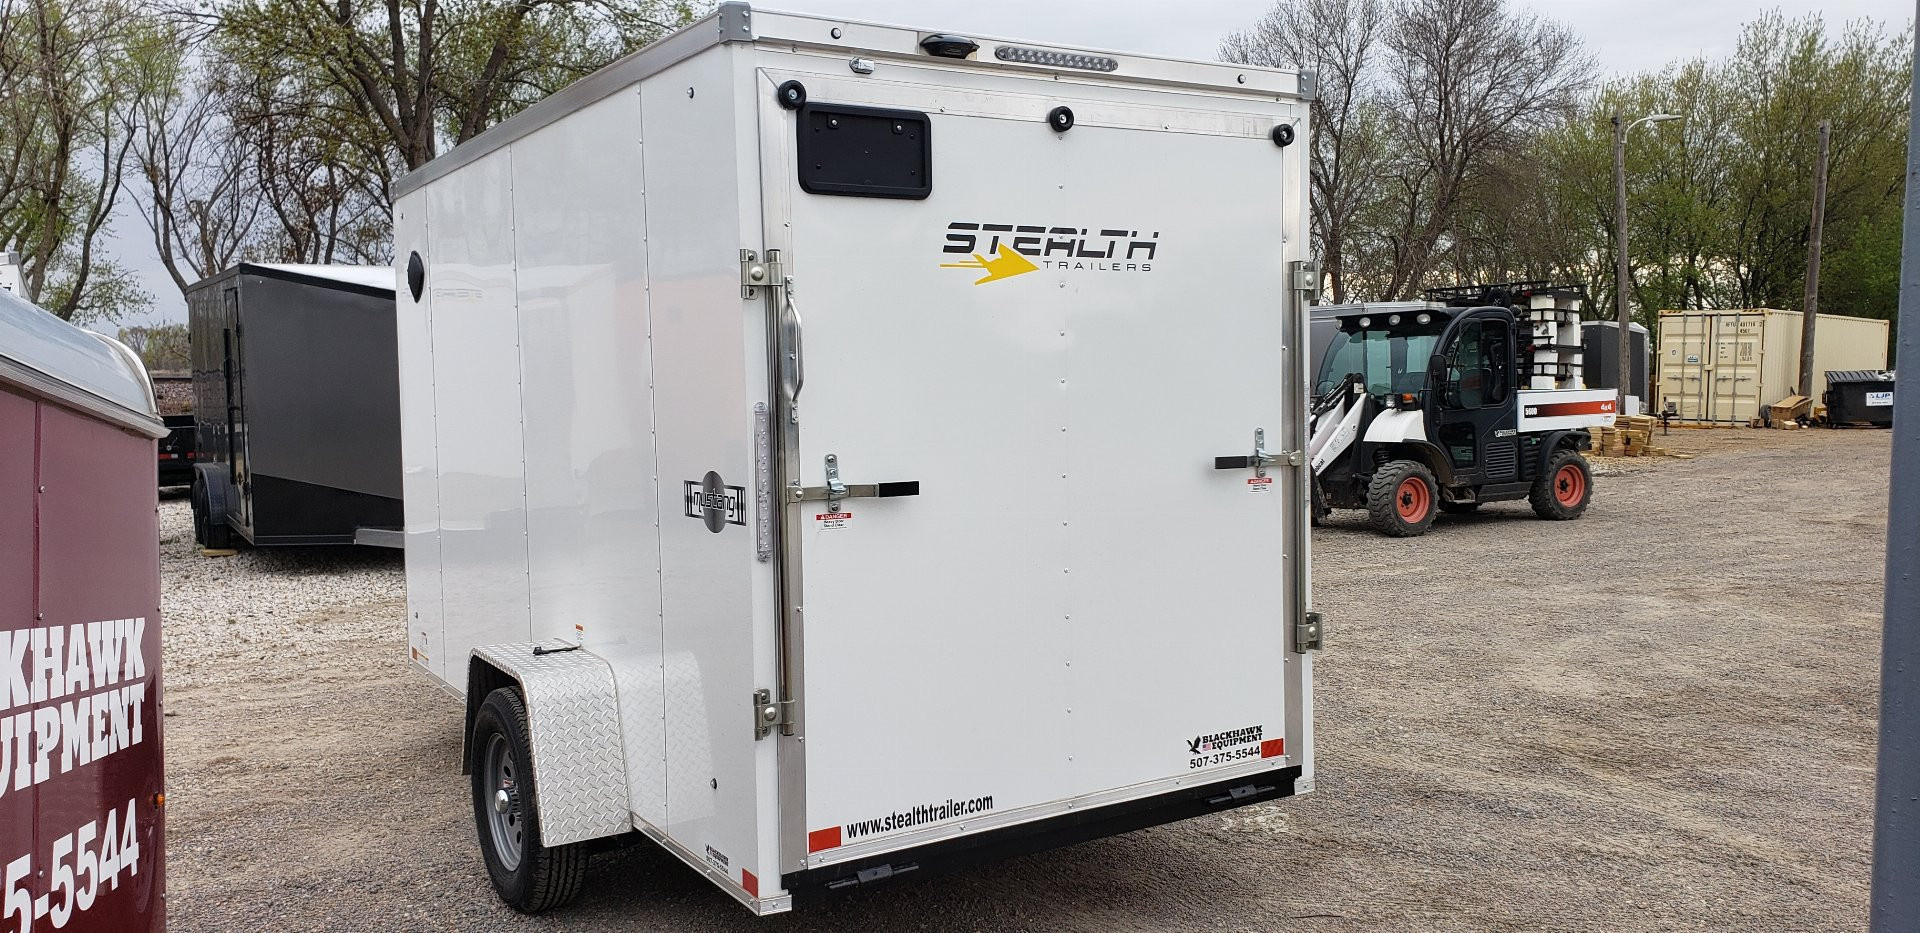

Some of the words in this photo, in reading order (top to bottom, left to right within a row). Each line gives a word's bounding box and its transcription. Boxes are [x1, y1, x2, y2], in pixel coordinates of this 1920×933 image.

[942, 222, 1160, 261] STEALTH
[1042, 260, 1153, 272] TRAILERS
[693, 487, 736, 518] mustang
[1202, 725, 1263, 744] BLACKHAWK
[1212, 733, 1263, 750] EQUIPMENT
[1189, 746, 1261, 769] 507-375-5544
[846, 795, 994, 839] www.stealthtrailer.com
